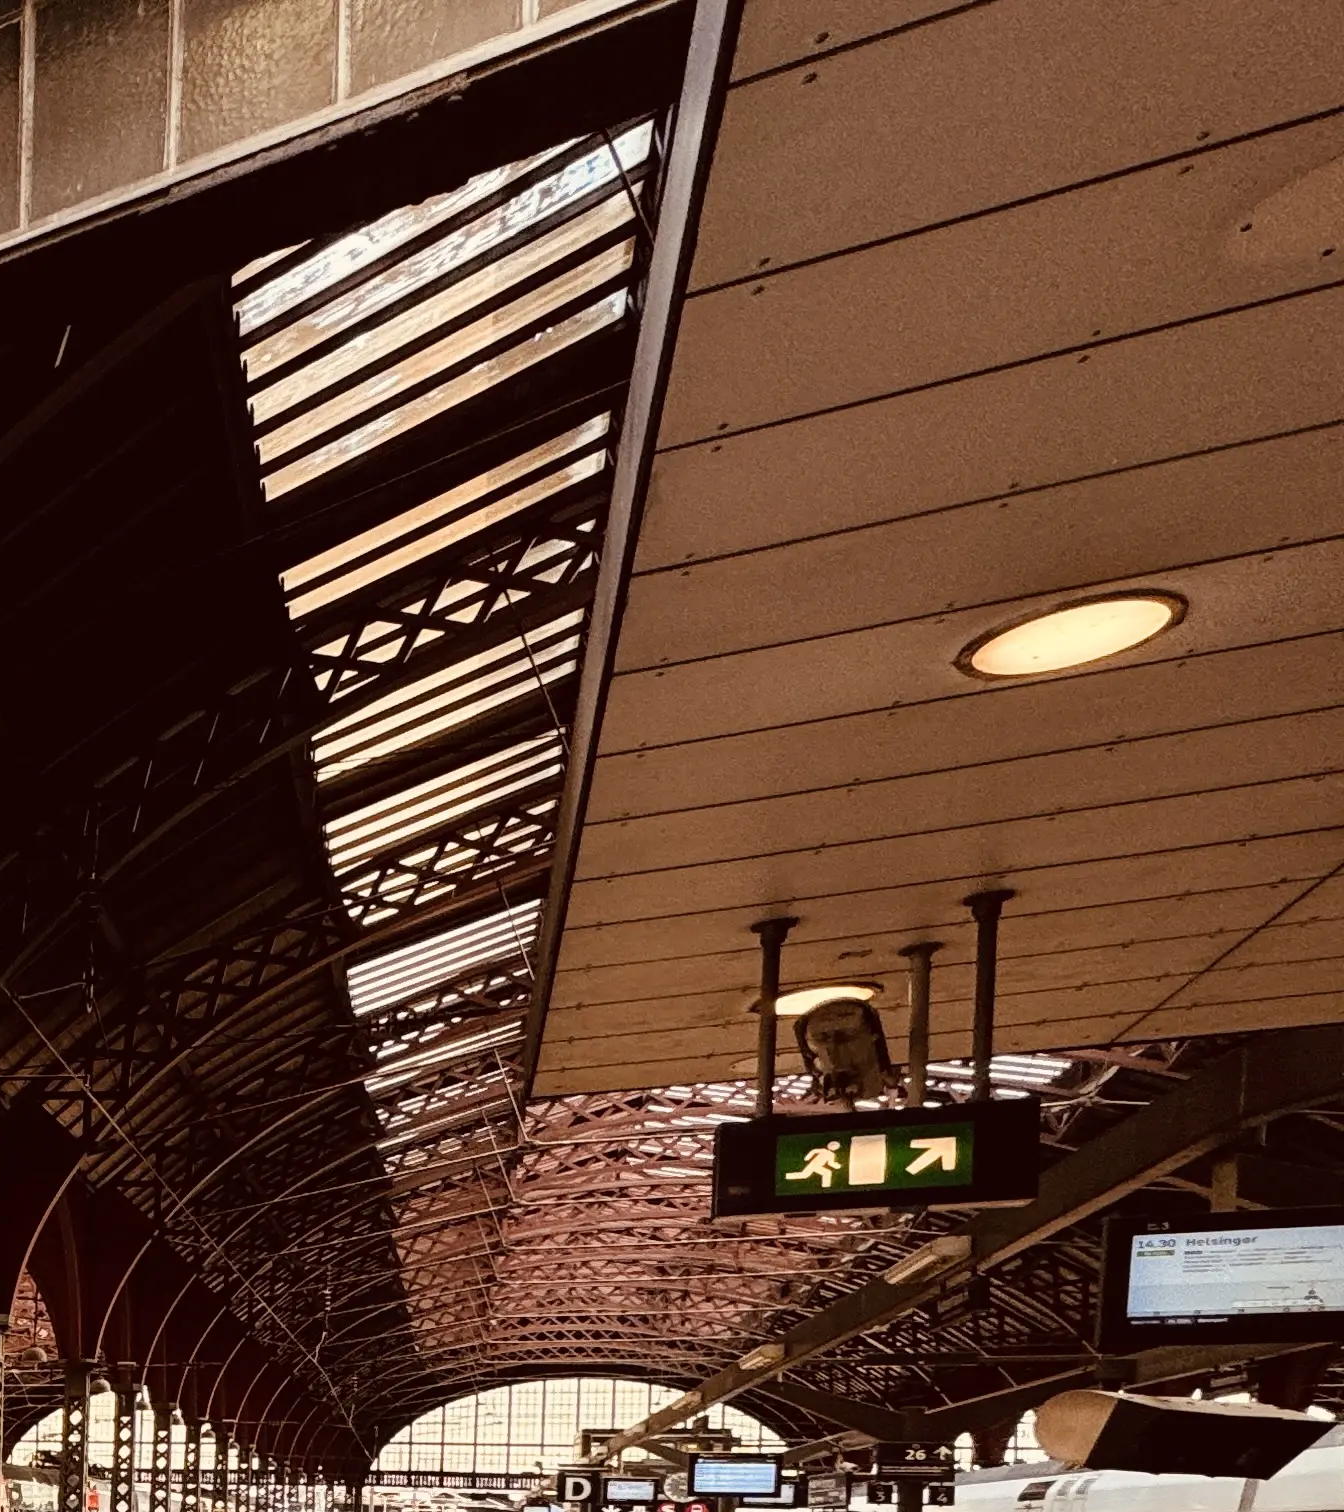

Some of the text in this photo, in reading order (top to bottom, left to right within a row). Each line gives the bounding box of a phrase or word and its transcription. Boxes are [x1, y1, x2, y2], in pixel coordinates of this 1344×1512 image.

[904, 1449, 927, 1461] 26
[565, 1477, 592, 1501] D
[875, 1491, 886, 1502] 3
[936, 1493, 948, 1504] 4
